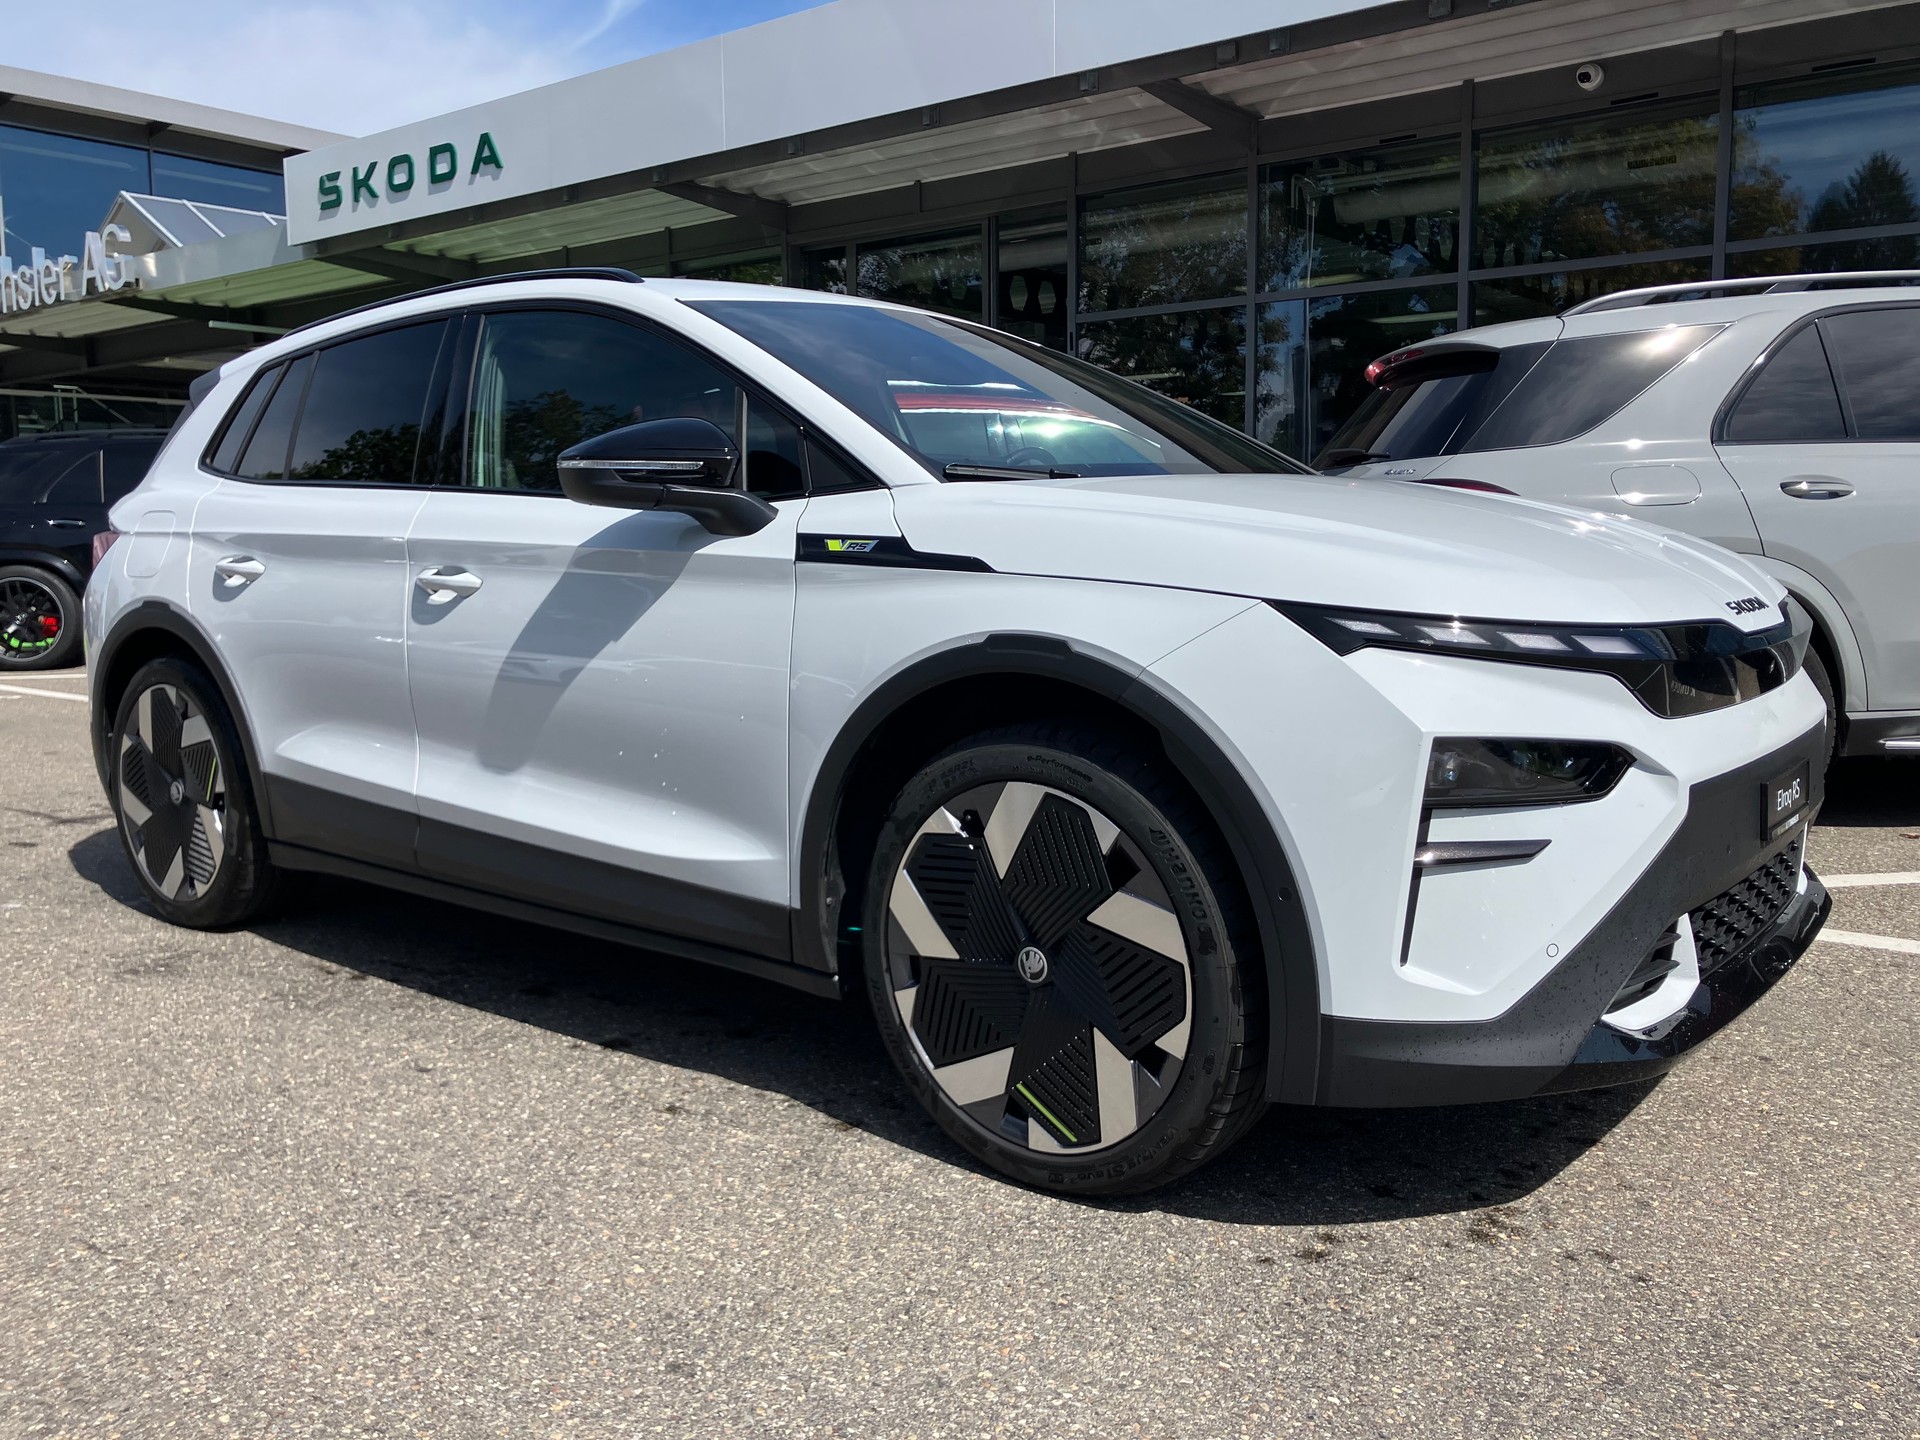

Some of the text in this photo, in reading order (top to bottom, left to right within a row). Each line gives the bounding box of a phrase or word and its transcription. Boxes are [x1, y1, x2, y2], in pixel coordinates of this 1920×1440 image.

[82, 223, 133, 296] AG
[1777, 778, 1800, 811] Elroq RS
